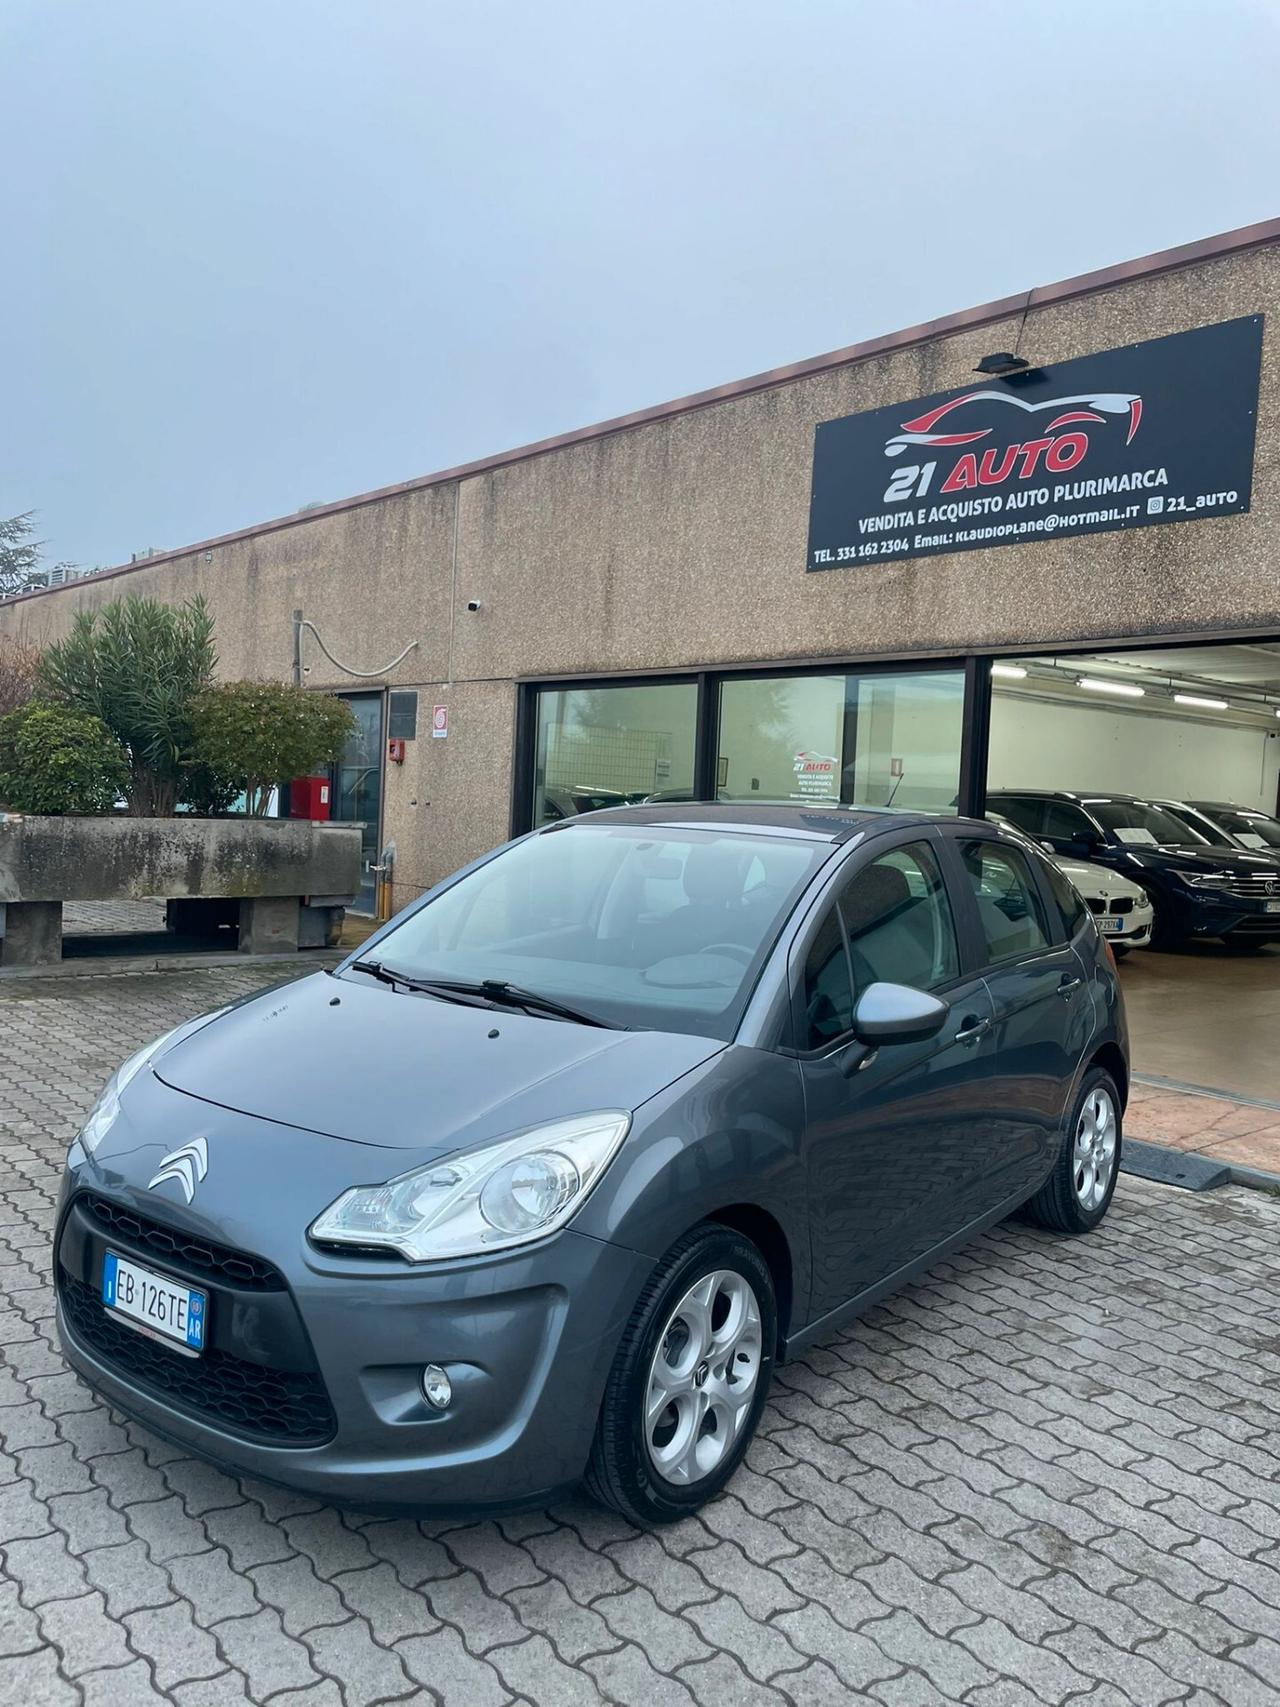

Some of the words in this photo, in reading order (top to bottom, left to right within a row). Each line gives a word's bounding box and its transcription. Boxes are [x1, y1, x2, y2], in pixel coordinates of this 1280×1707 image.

[883, 461, 937, 502] 21
[939, 432, 1089, 493] AUTO
[858, 510, 915, 534] VENDITA
[917, 508, 926, 525] E
[928, 495, 1003, 523] ACQUISTO
[1005, 487, 1050, 510] AUTO
[1053, 468, 1169, 503] PLURIMARCA
[814, 548, 836, 563] TEL.
[836, 545, 857, 561] 331
[858, 542, 879, 557] 162
[880, 537, 910, 554] 2304
[805, 761, 832, 772] AUTO
[116, 1269, 135, 1305] EB
[142, 1281, 187, 1332] 126TE
[188, 1318, 201, 1340] AR
